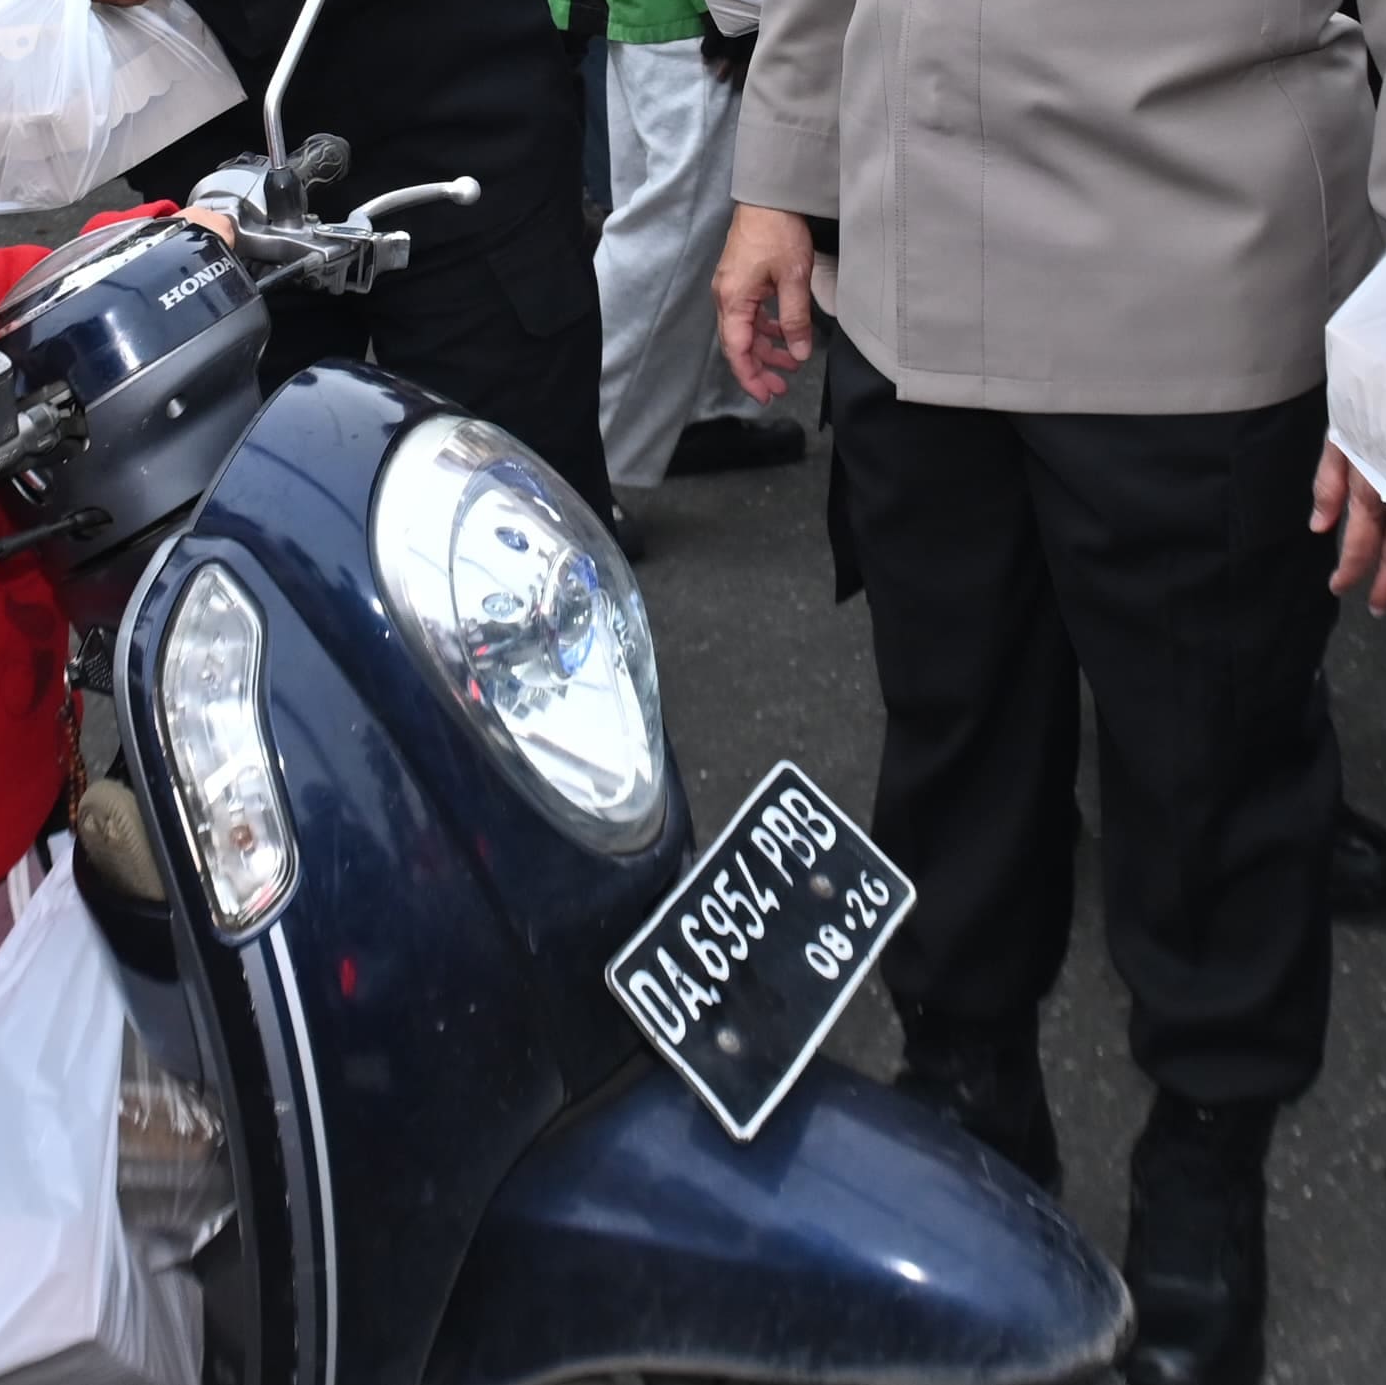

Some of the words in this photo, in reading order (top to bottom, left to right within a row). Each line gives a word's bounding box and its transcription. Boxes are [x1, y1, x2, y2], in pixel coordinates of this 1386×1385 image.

[158, 257, 234, 310] HONDA
[681, 851, 781, 982] 6954
[751, 787, 837, 887] PBB
